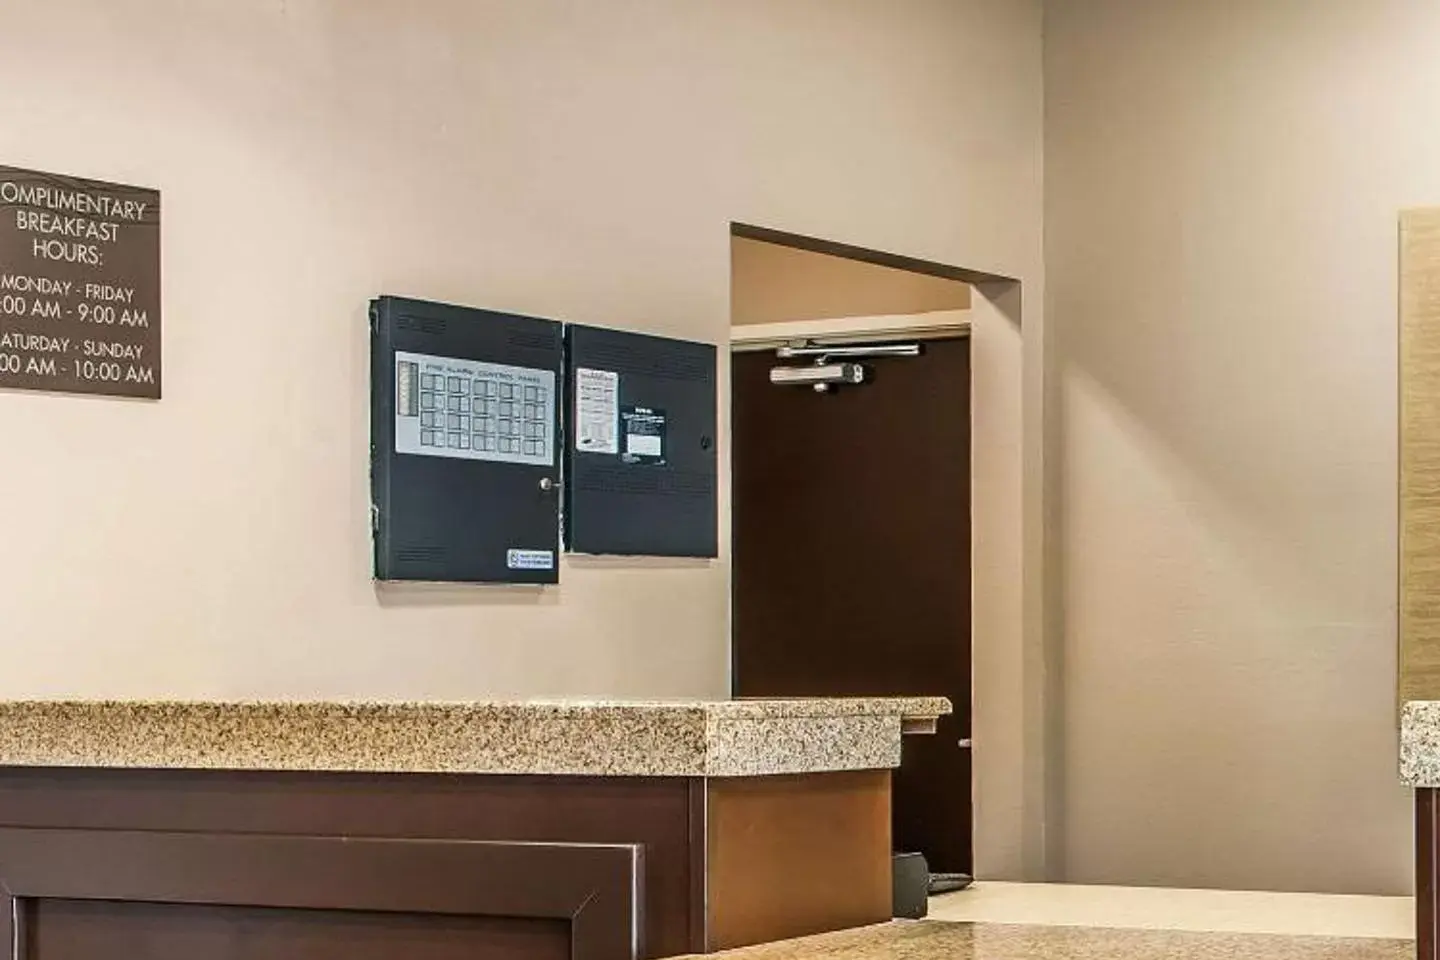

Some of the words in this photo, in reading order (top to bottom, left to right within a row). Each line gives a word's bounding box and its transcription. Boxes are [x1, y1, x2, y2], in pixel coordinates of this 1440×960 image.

[0, 182, 147, 220] OMPLIMENTARY
[16, 210, 120, 242] BREAKFAST
[33, 238, 103, 266] HOURS:
[1, 274, 72, 297] MONDAY
[85, 283, 134, 304] FRIDAY
[0, 295, 26, 315] :00
[30, 298, 61, 319] AM
[78, 302, 115, 325] 9:00
[120, 309, 149, 328] AM
[0, 332, 70, 353] ATURDAY
[83, 340, 143, 360] SUNDAY
[0, 352, 21, 374] 00
[25, 356, 57, 376] AM
[74, 359, 121, 381] 10:00
[125, 363, 155, 385] AM
